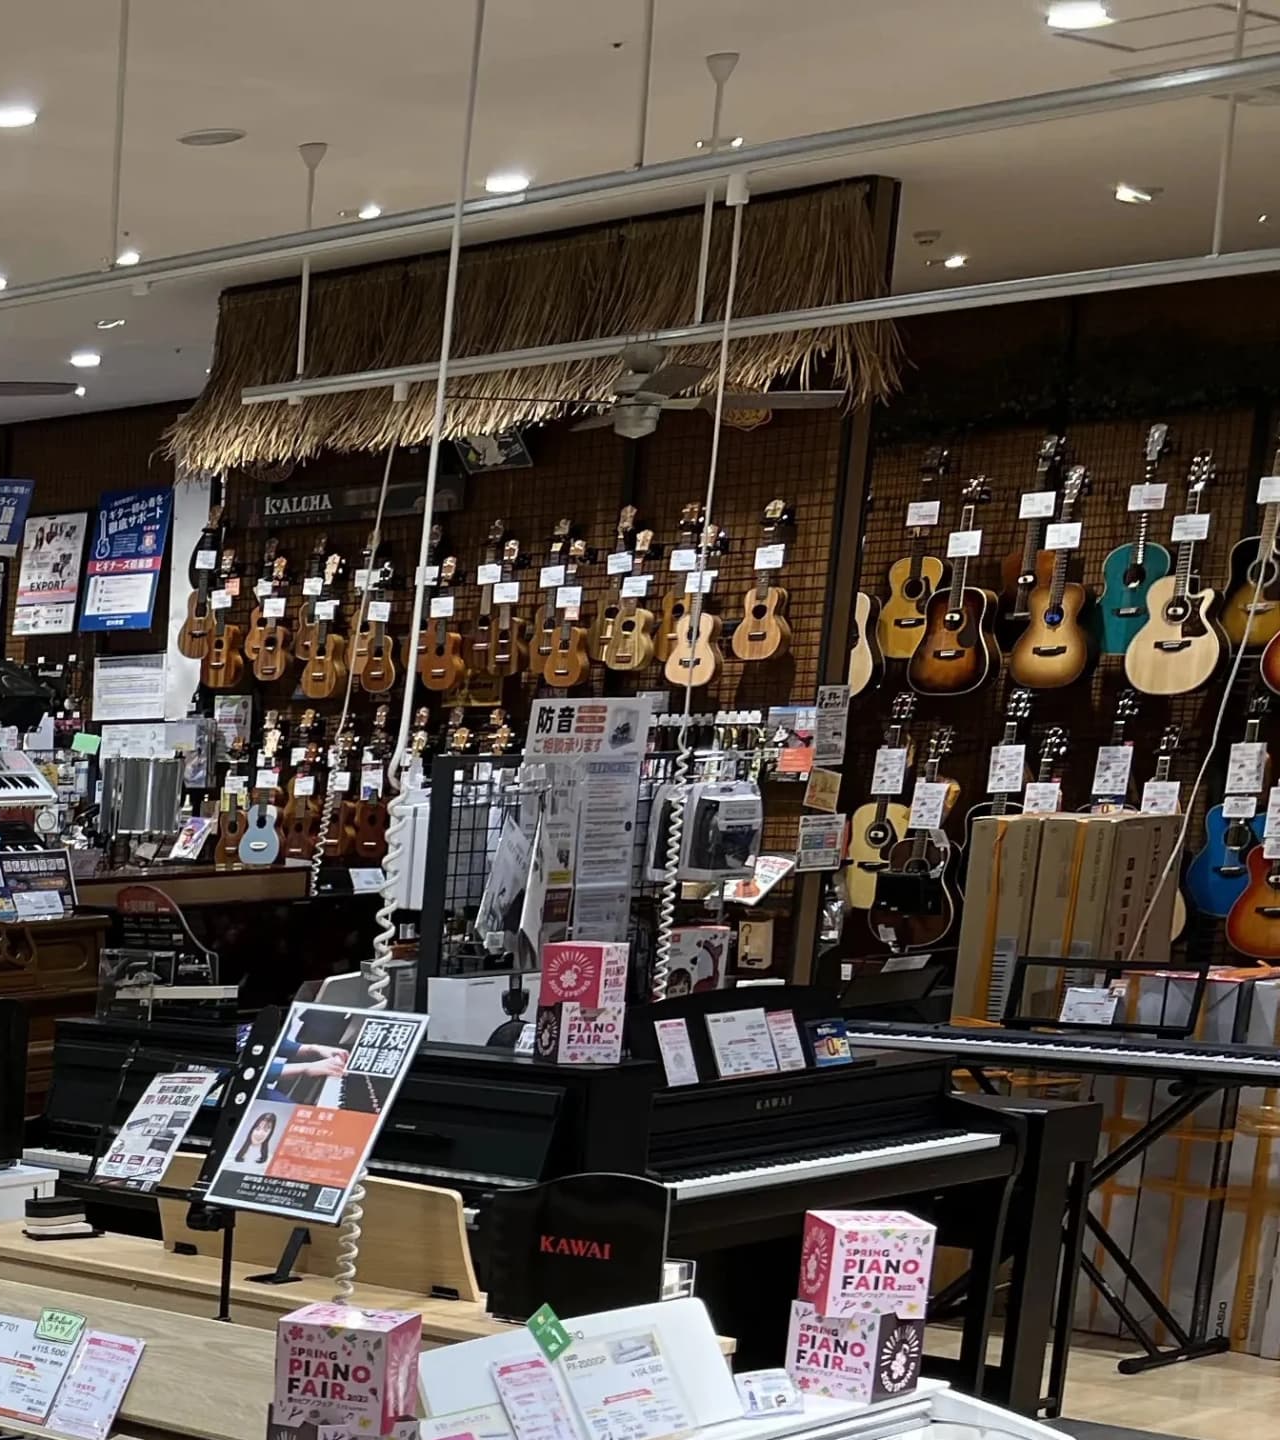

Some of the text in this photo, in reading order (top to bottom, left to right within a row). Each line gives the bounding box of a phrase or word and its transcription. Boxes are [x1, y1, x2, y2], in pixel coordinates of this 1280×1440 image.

[30, 580, 66, 592] EXPORT
[536, 705, 575, 734] 防音
[359, 1022, 411, 1049] 新規
[568, 1023, 616, 1033] PIANO
[567, 1034, 601, 1044] FAIR
[349, 1046, 404, 1075] 開講
[540, 1234, 613, 1260] KAWAI
[846, 1248, 890, 1257] SPRING
[843, 1258, 920, 1274] PIANO
[841, 1275, 897, 1291] FAIR
[800, 1323, 839, 1337] SPRING
[290, 1346, 338, 1361] SPRING
[798, 1333, 866, 1357] PIANO
[796, 1350, 846, 1371] FAIR
[289, 1359, 371, 1385] PIANO
[288, 1377, 345, 1400] FAIR
